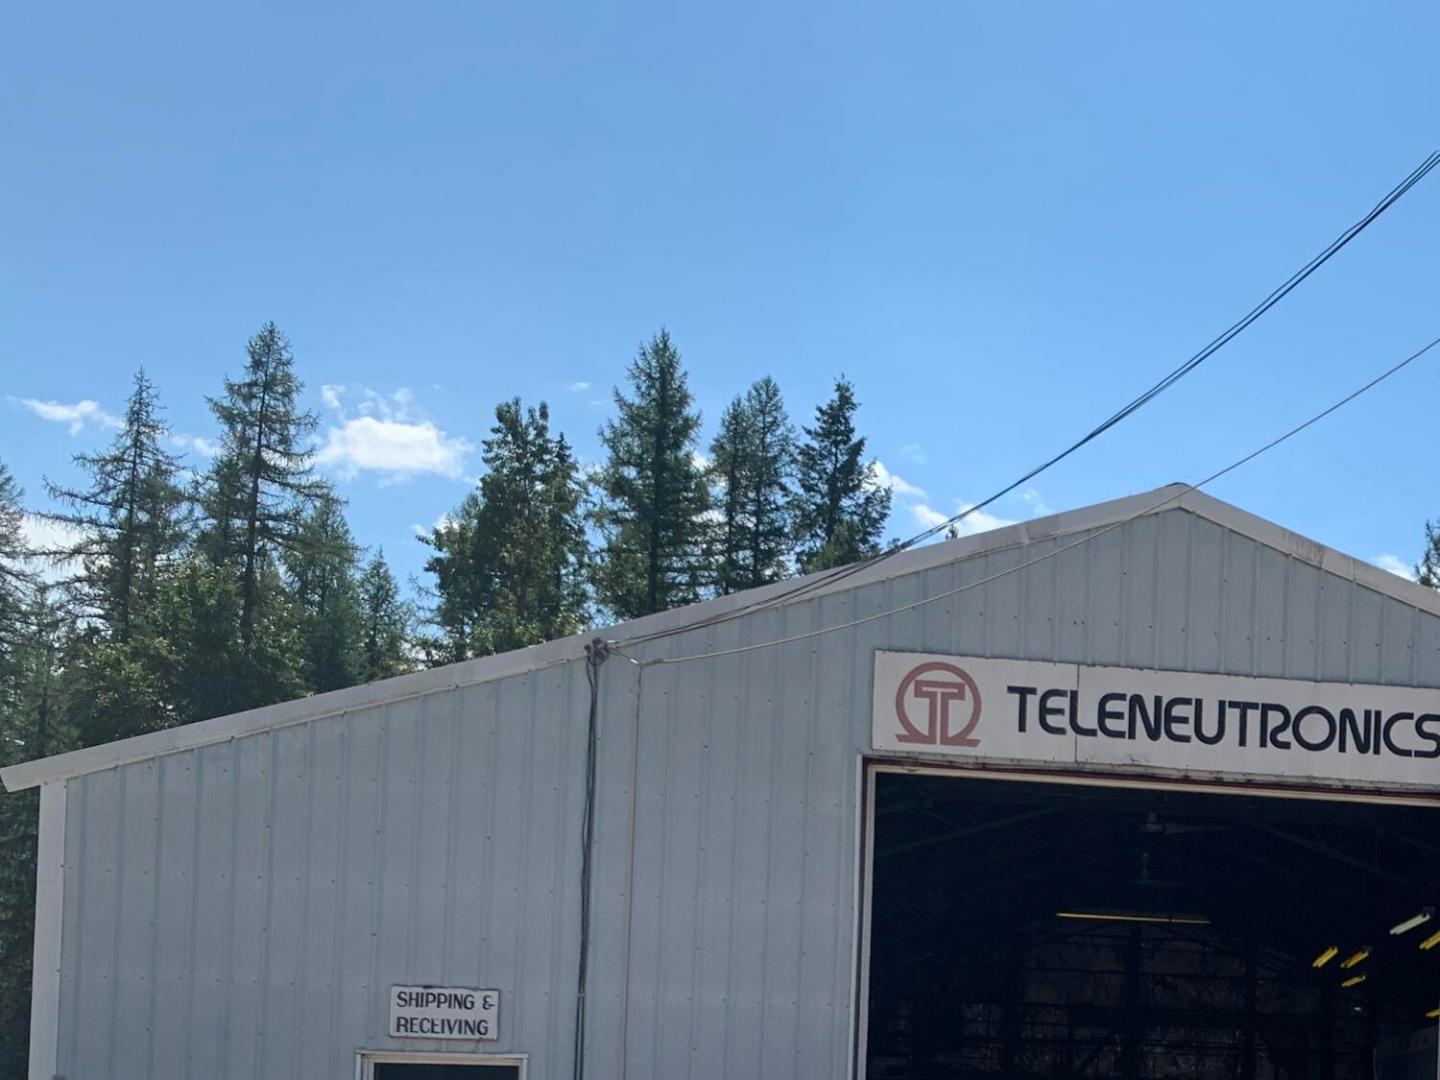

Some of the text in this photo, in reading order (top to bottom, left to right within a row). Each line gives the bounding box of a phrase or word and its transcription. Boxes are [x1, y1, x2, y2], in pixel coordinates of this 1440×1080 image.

[397, 990, 496, 1010] SHIPPING &
[396, 1015, 489, 1036] RECEIVING
